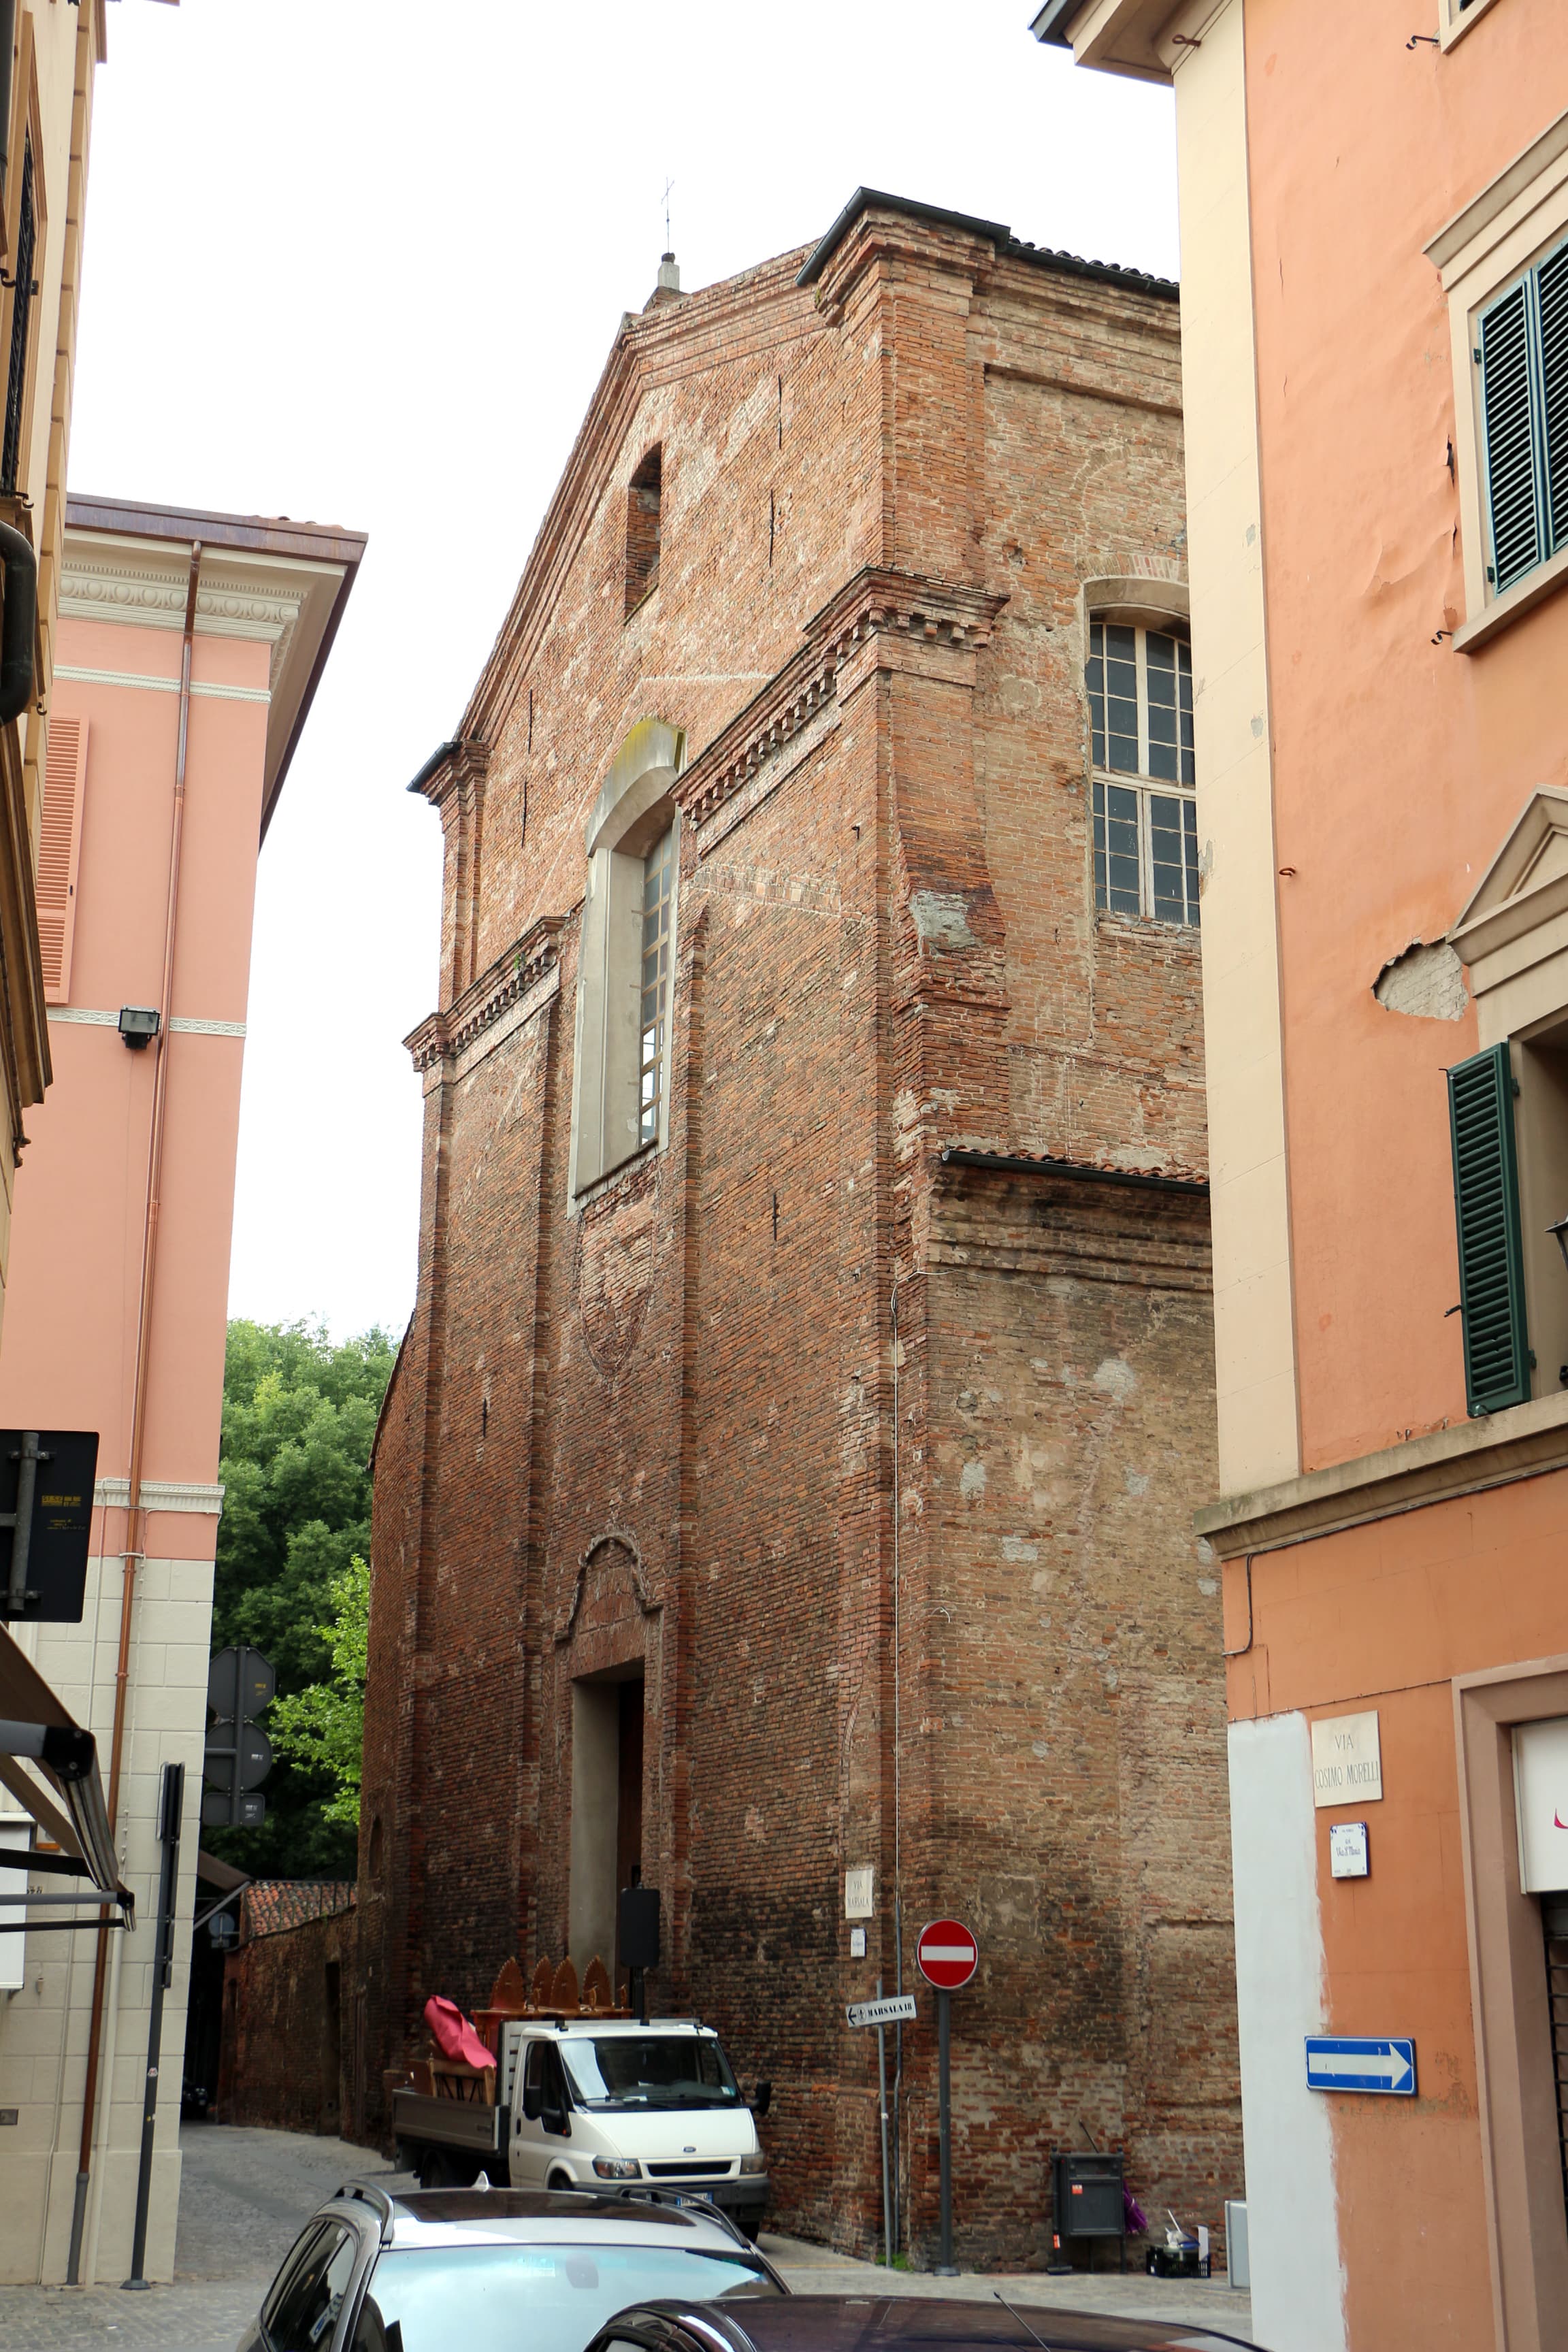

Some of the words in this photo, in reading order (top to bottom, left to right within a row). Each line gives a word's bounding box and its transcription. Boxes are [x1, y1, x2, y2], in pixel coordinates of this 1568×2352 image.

[1335, 1733, 1354, 1750] VIA
[1314, 1765, 1343, 1790] COSIMO
[1346, 1760, 1379, 1785] MORELLI
[853, 1880, 864, 1890] VIA
[847, 1895, 870, 1908] MARSALA
[868, 2004, 902, 2017] MARSALA
